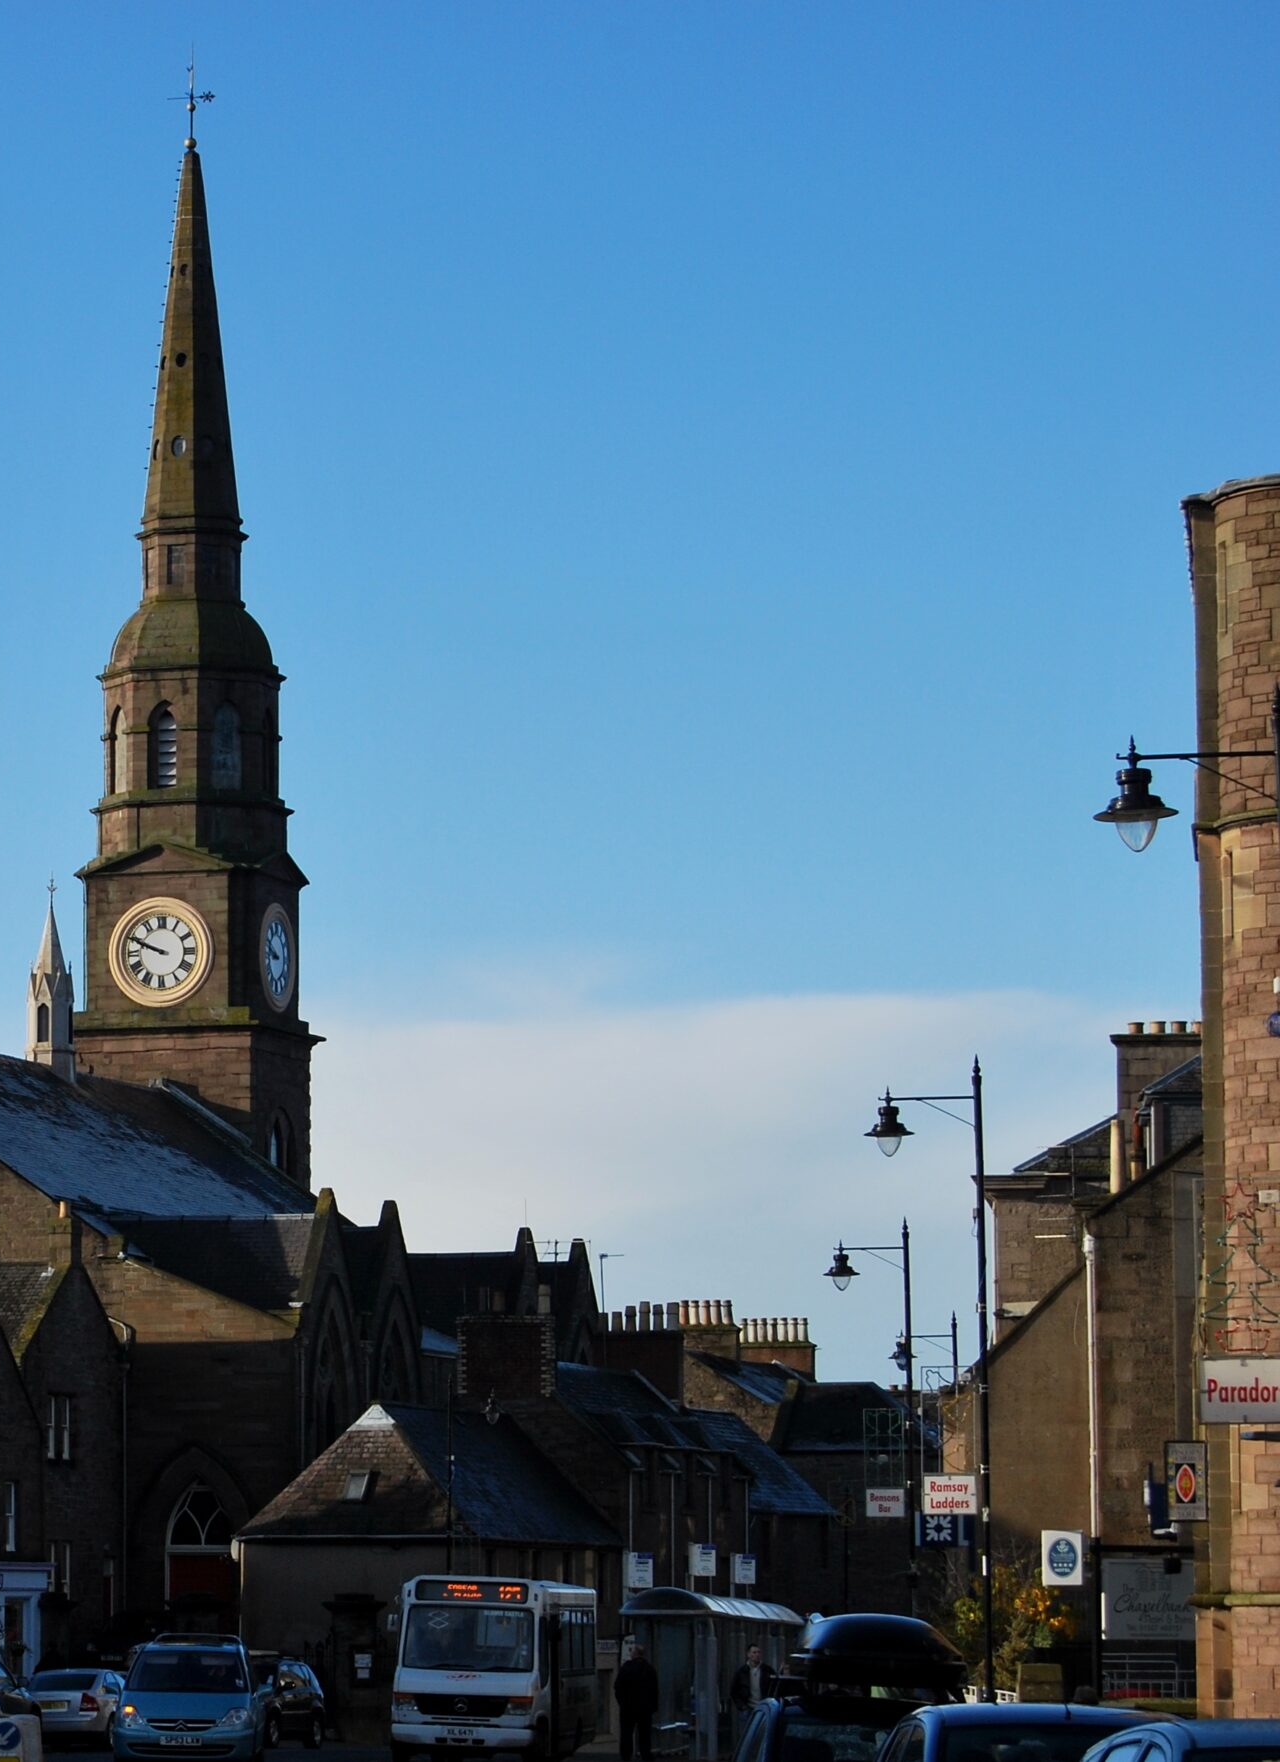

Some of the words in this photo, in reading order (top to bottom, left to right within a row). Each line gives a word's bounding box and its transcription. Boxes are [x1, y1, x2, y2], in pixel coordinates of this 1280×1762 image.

[1207, 1377, 1279, 1403] Parador
[930, 1481, 969, 1494] Ramsay
[870, 1493, 900, 1502] Bensons
[931, 1497, 970, 1509] Ladders
[878, 1503, 891, 1513] Bar
